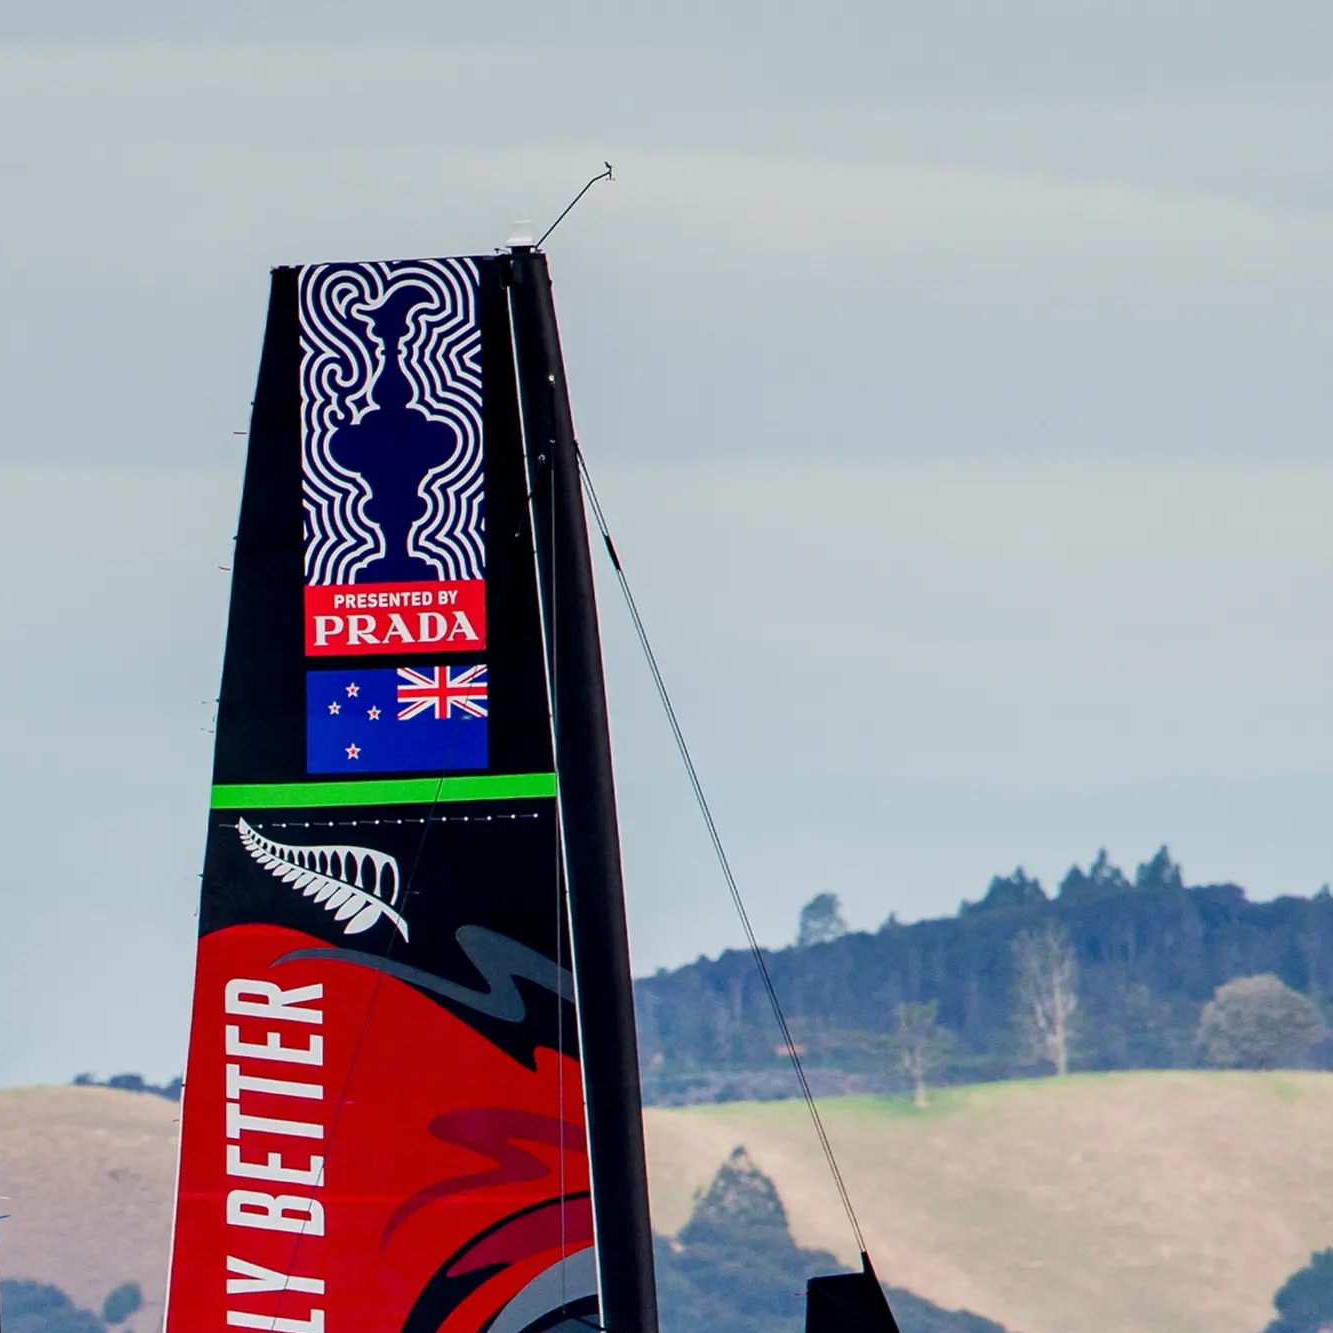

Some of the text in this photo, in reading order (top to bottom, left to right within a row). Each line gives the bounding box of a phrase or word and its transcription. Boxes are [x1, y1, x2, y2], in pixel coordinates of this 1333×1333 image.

[334, 590, 458, 609] PRESENTED BY
[313, 610, 479, 646] PRADA
[224, 978, 325, 1237] BETTER
